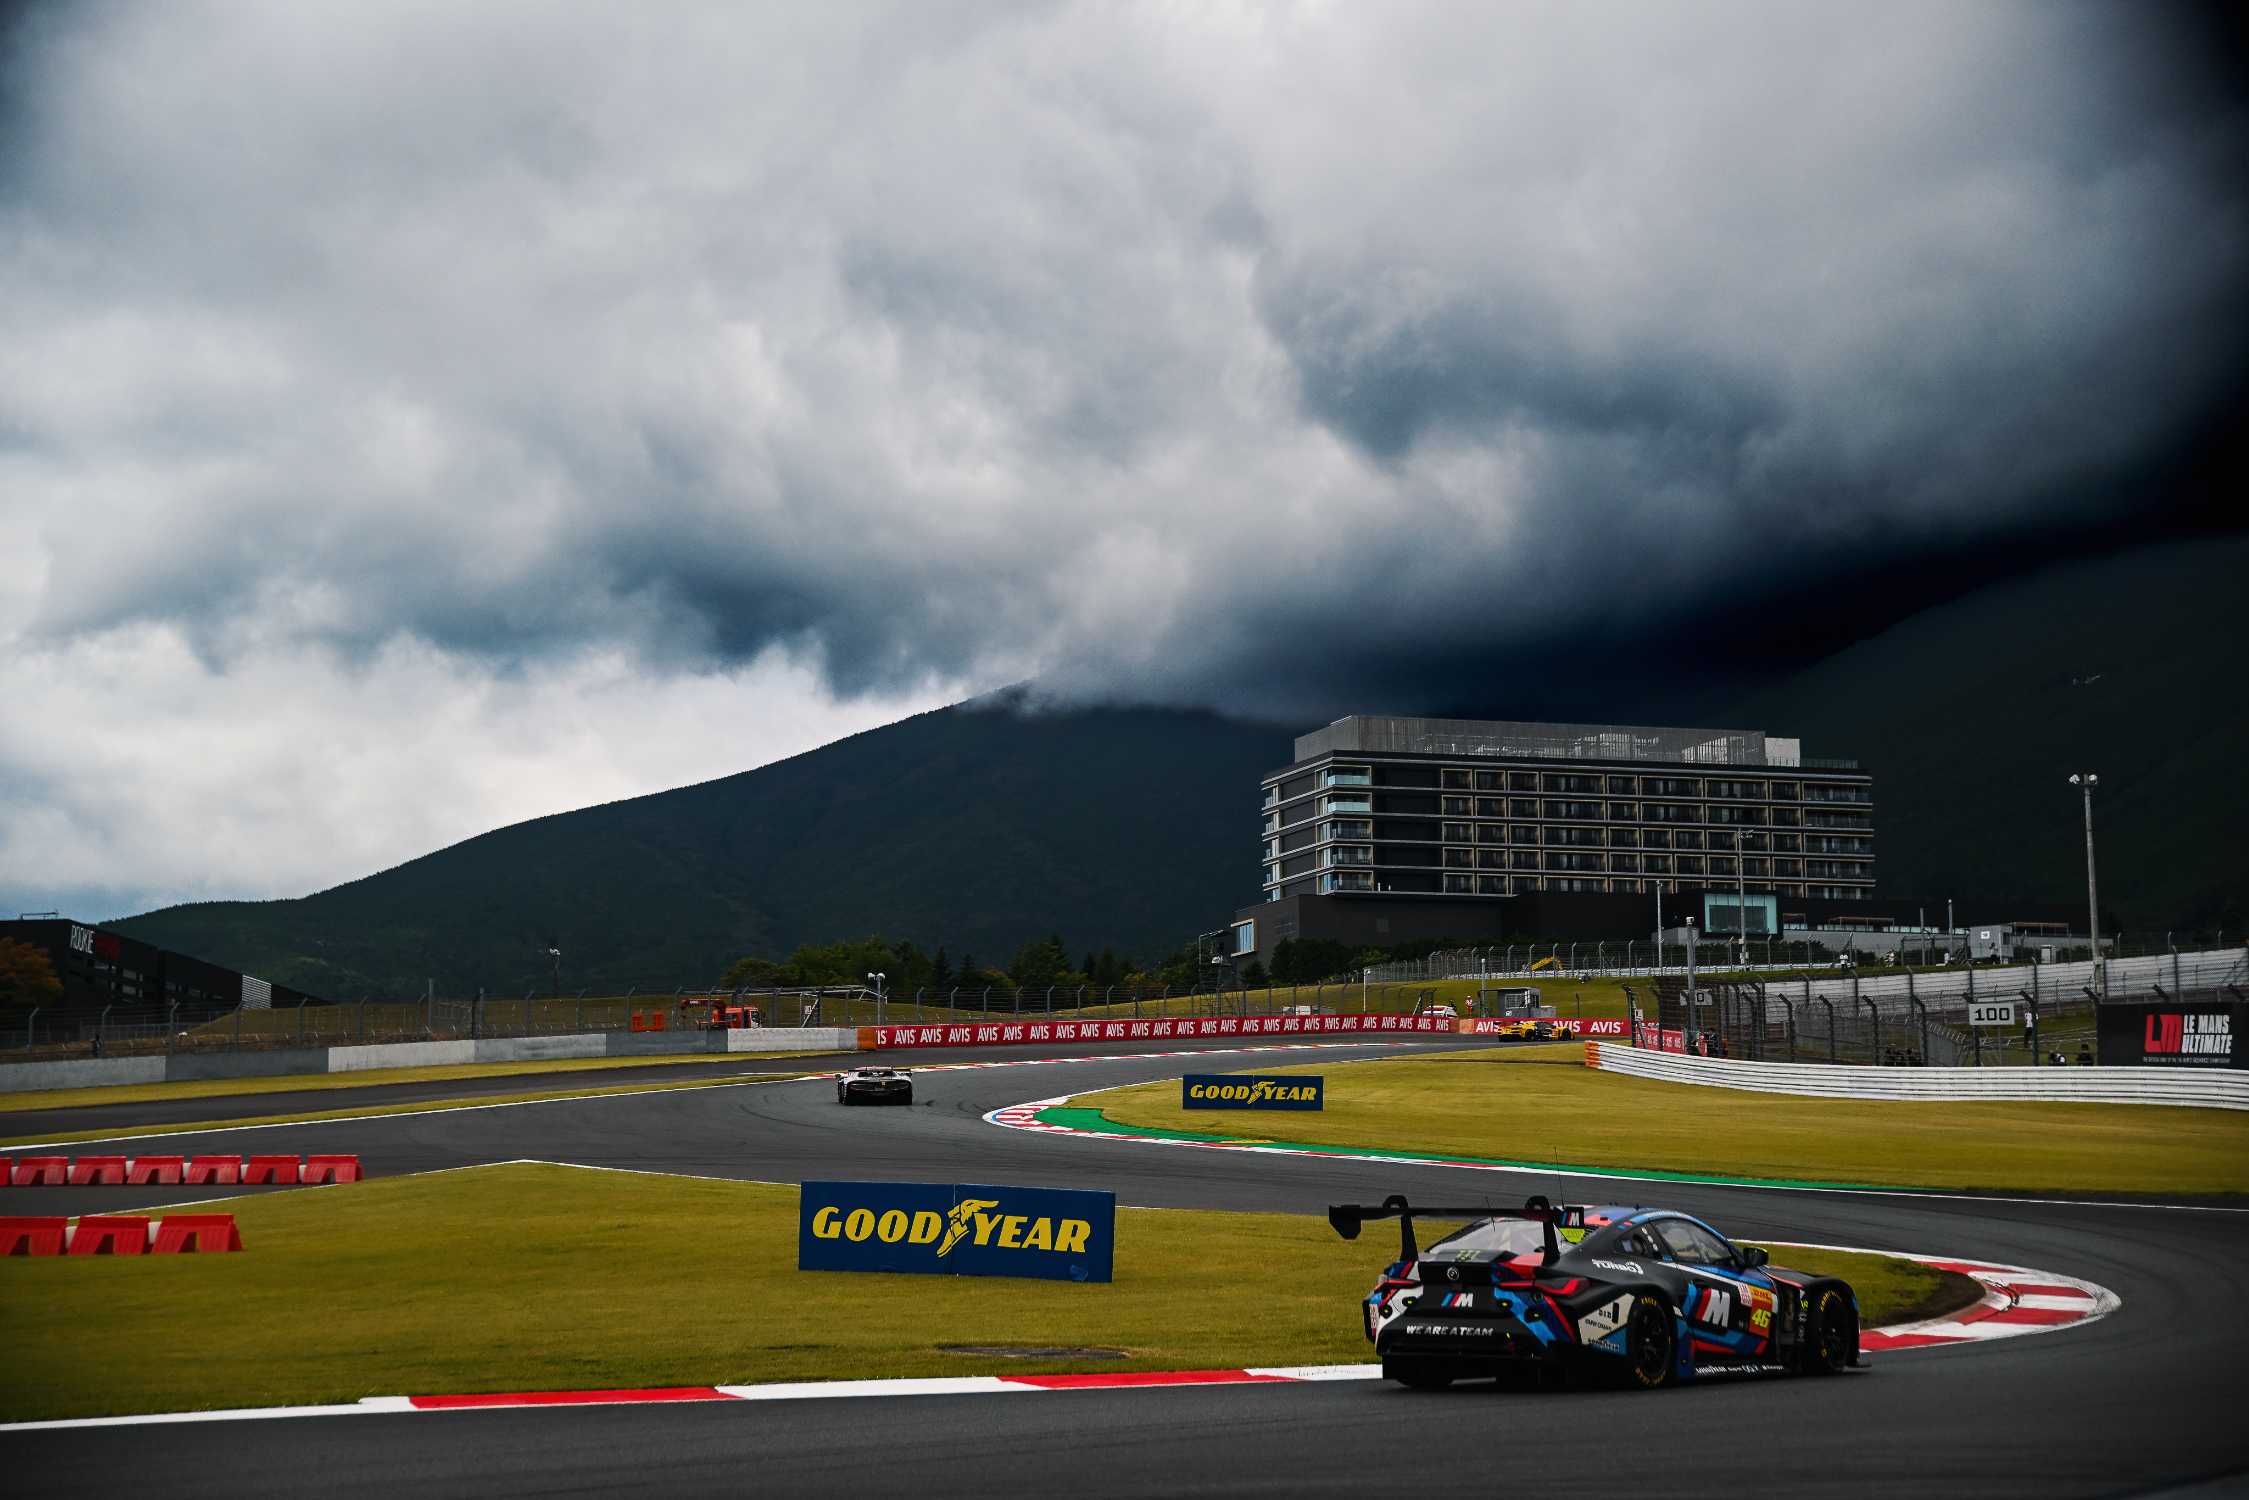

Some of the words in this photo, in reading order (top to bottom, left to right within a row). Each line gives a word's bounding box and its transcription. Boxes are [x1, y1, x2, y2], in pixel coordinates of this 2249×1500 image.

[1974, 1008, 2010, 1021] 100
[2184, 1014, 2195, 1033] LE
[2198, 1014, 2230, 1033] MANS
[894, 1029, 916, 1044] AVIS
[920, 1028, 943, 1043] AVIS
[949, 1028, 971, 1042] AVIS
[977, 1026, 999, 1041] AVIS
[1003, 1025, 1023, 1040] AVIS
[1030, 1025, 1049, 1039] AVIS
[1056, 1024, 1075, 1038] AVIS
[1080, 1023, 1100, 1037] AVIS
[1106, 1023, 1126, 1037] AVIS
[1131, 1022, 1149, 1036] AVIS
[1154, 1022, 1171, 1036] AVIS
[1177, 1021, 1196, 1035] AVIS
[1201, 1021, 1217, 1034] AVIS
[1220, 1020, 1237, 1033] AVIS
[1242, 1019, 1259, 1032] AVIS
[1263, 1019, 1280, 1031] AVIS
[1284, 1019, 1299, 1031] AVIS
[1304, 1018, 1320, 1030] AVIS
[1324, 1018, 1340, 1030] AVIS
[1342, 1018, 1357, 1030] AVIS
[1363, 1017, 1377, 1029] AVIS
[1381, 1017, 1396, 1029] AVIS
[1400, 1017, 1413, 1030] AVIS
[1417, 1018, 1431, 1030] AVIS
[1436, 1019, 1450, 1031] AVIS
[1590, 1021, 1621, 1034] AVIS
[2181, 1034, 2232, 1053] ULTIMATE
[1190, 1084, 1317, 1101] GOODYEAR
[812, 1203, 1092, 1254] GOODYEAR
[1455, 1293, 1474, 1308] M
[1702, 1288, 1731, 1328] M
[1752, 1309, 1771, 1329] 46
[1406, 1325, 1423, 1335] WE
[1426, 1326, 1449, 1336] ARE
[1449, 1326, 1458, 1336] A
[1459, 1326, 1495, 1337] TEAM
